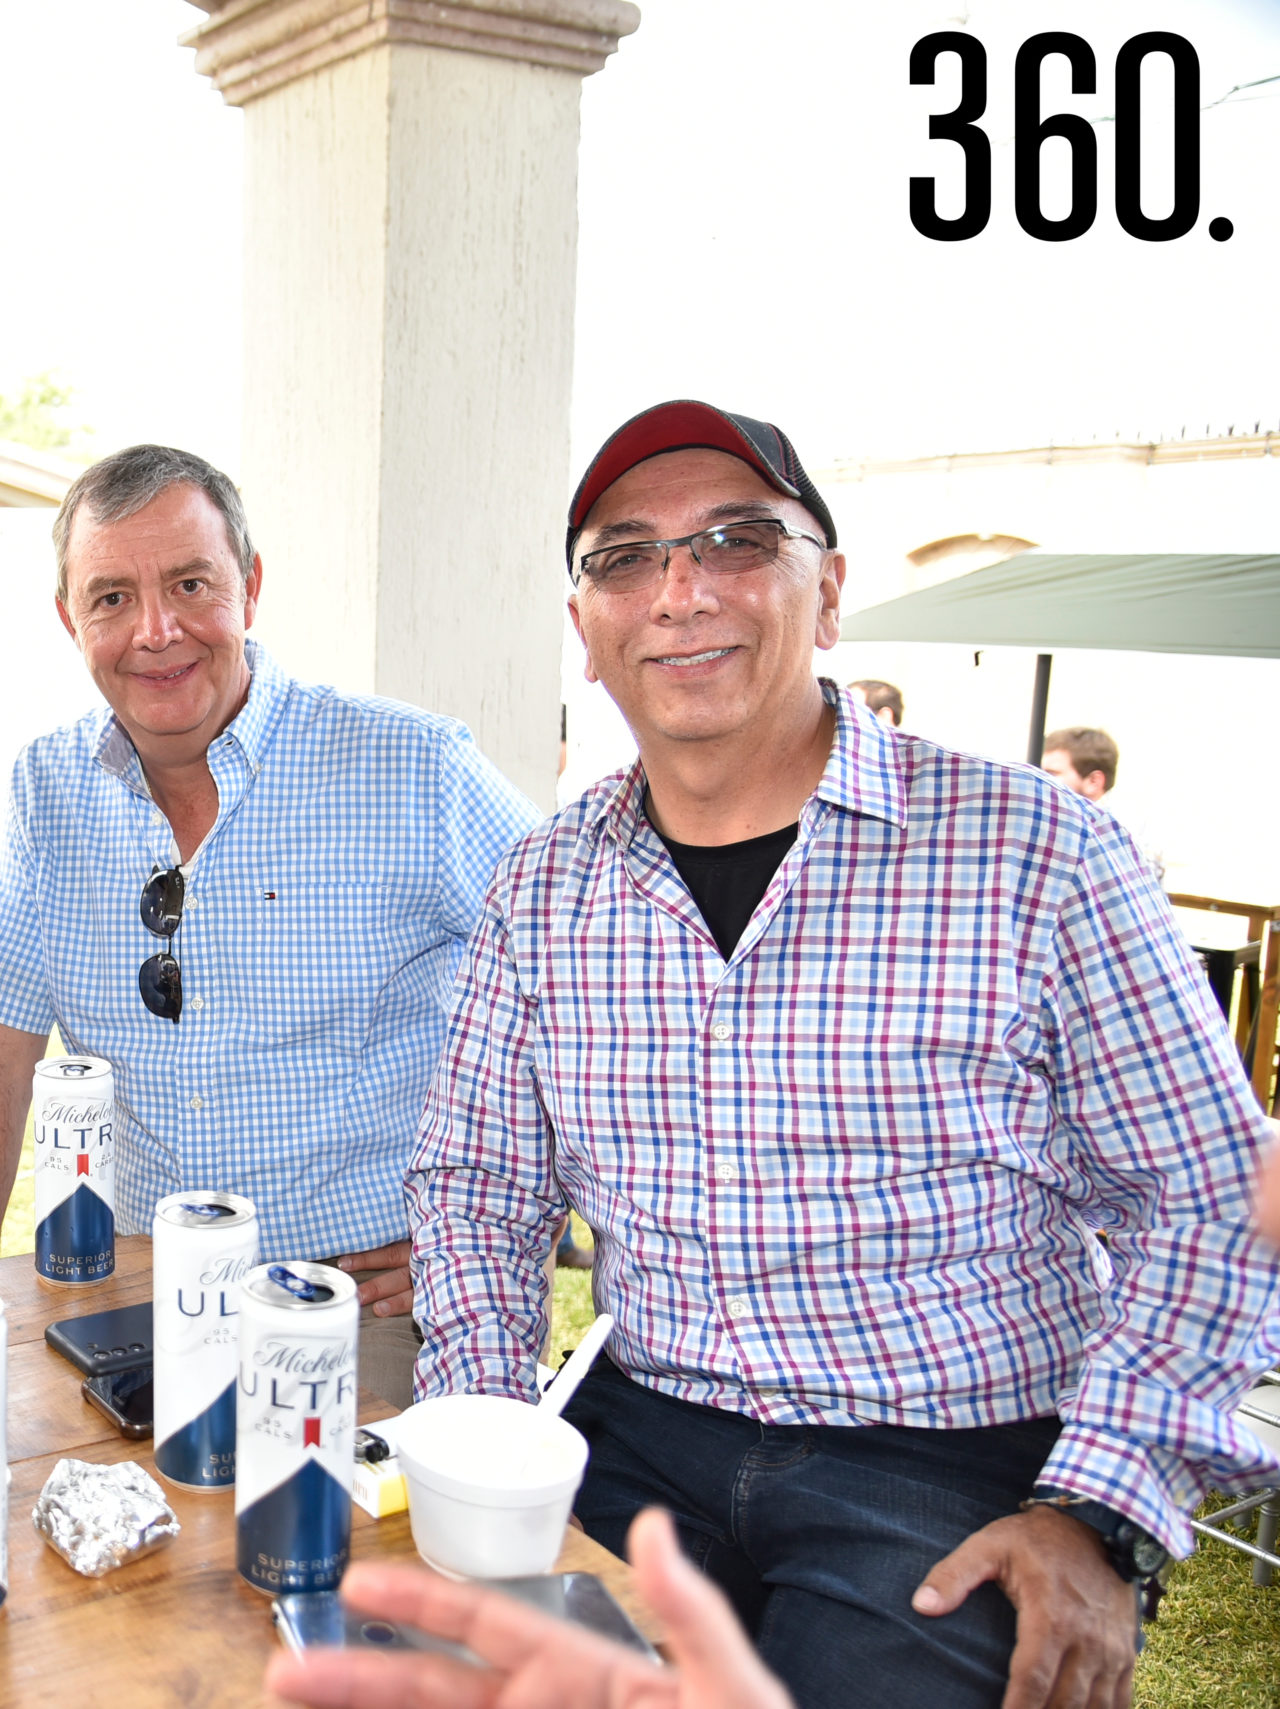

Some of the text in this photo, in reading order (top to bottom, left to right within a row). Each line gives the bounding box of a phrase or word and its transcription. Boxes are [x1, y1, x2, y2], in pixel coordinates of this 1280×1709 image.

[49, 1250, 111, 1265] SUPERIOR
[45, 1258, 113, 1275] LIGHT BEER
